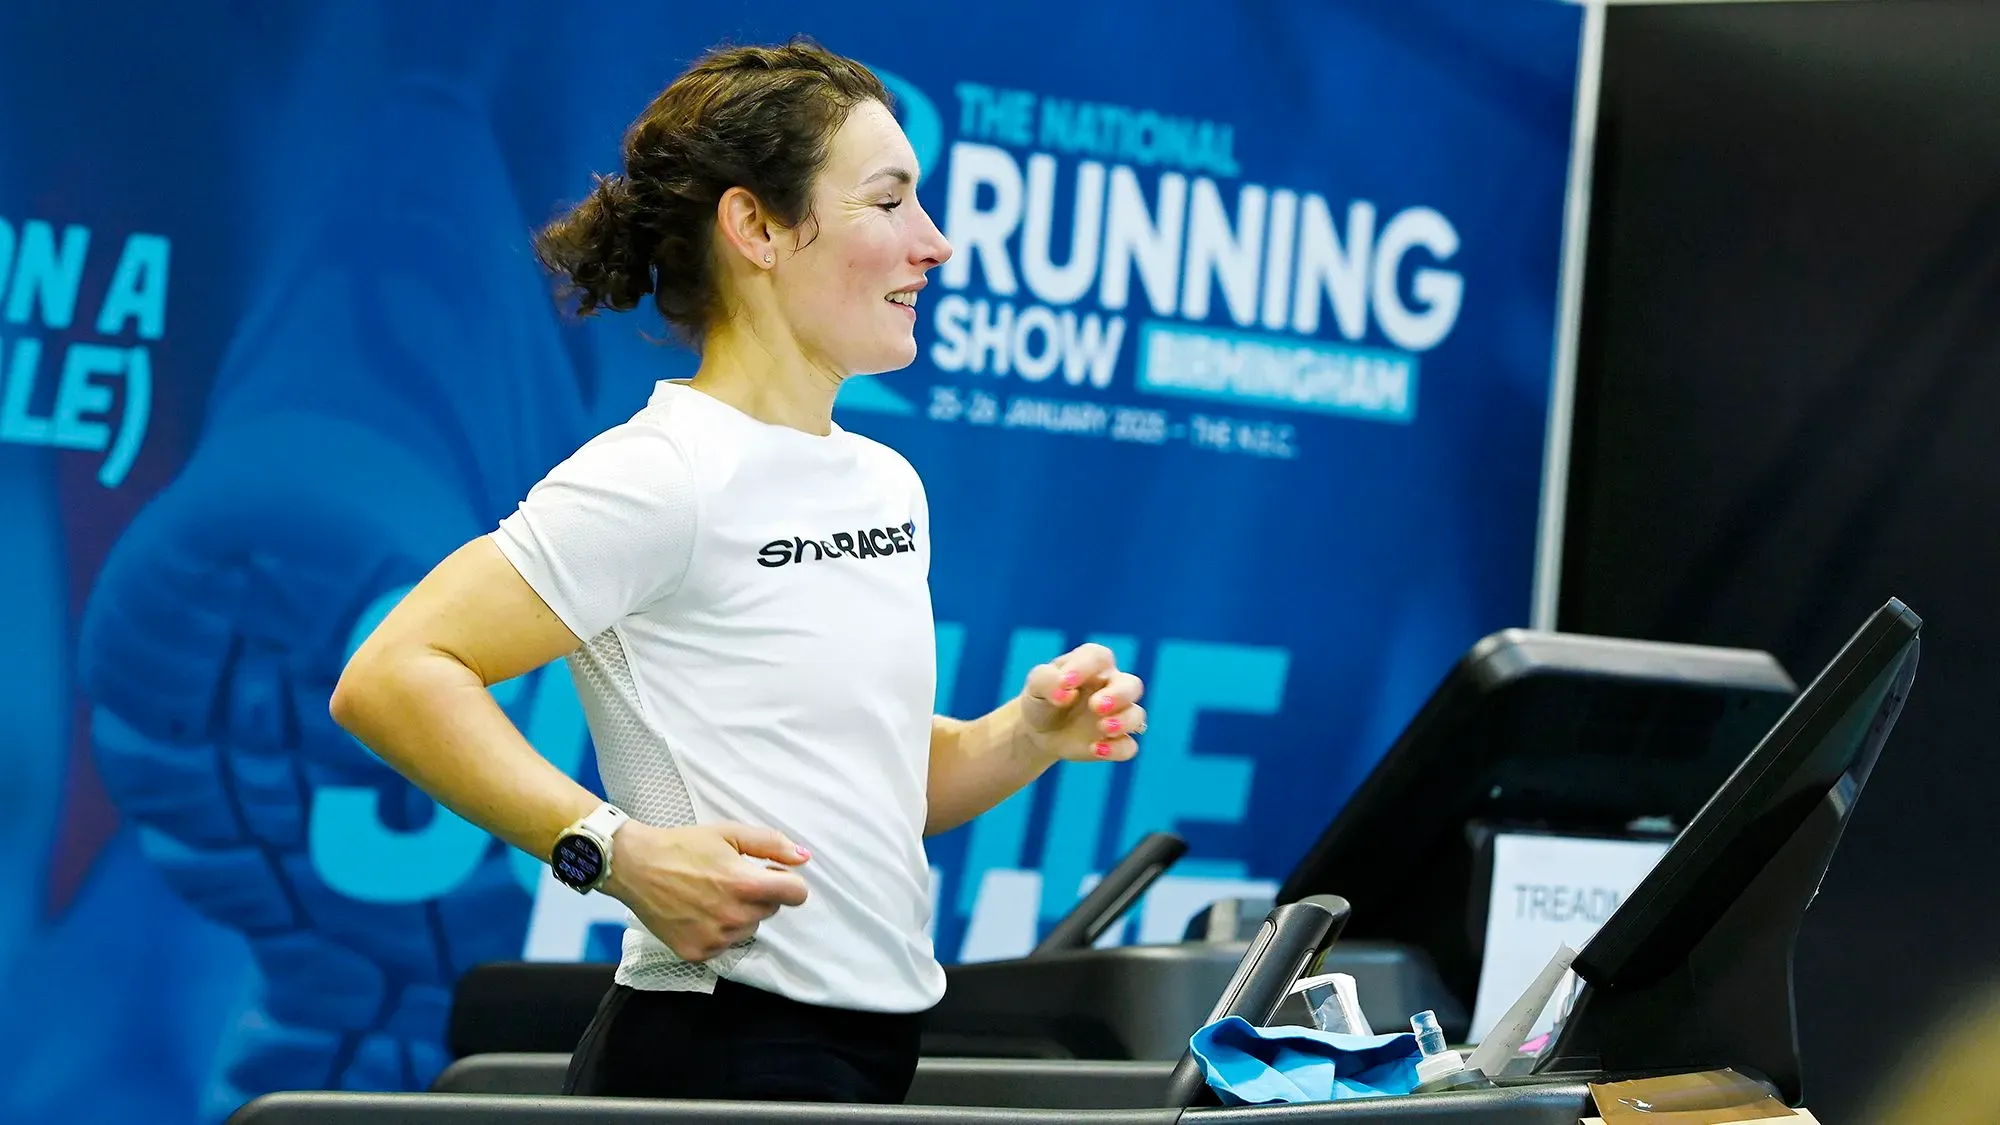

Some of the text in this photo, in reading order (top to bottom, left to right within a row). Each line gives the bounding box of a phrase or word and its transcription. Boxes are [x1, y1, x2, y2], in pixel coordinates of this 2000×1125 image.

[954, 81, 1240, 176] THE NATIONAL
[95, 232, 170, 340] A
[940, 141, 1463, 351] RUNNING
[931, 296, 1408, 408] SHOW BIRMINGHAM
[0, 337, 152, 489] LE)
[1513, 884, 1622, 925] TREAD
